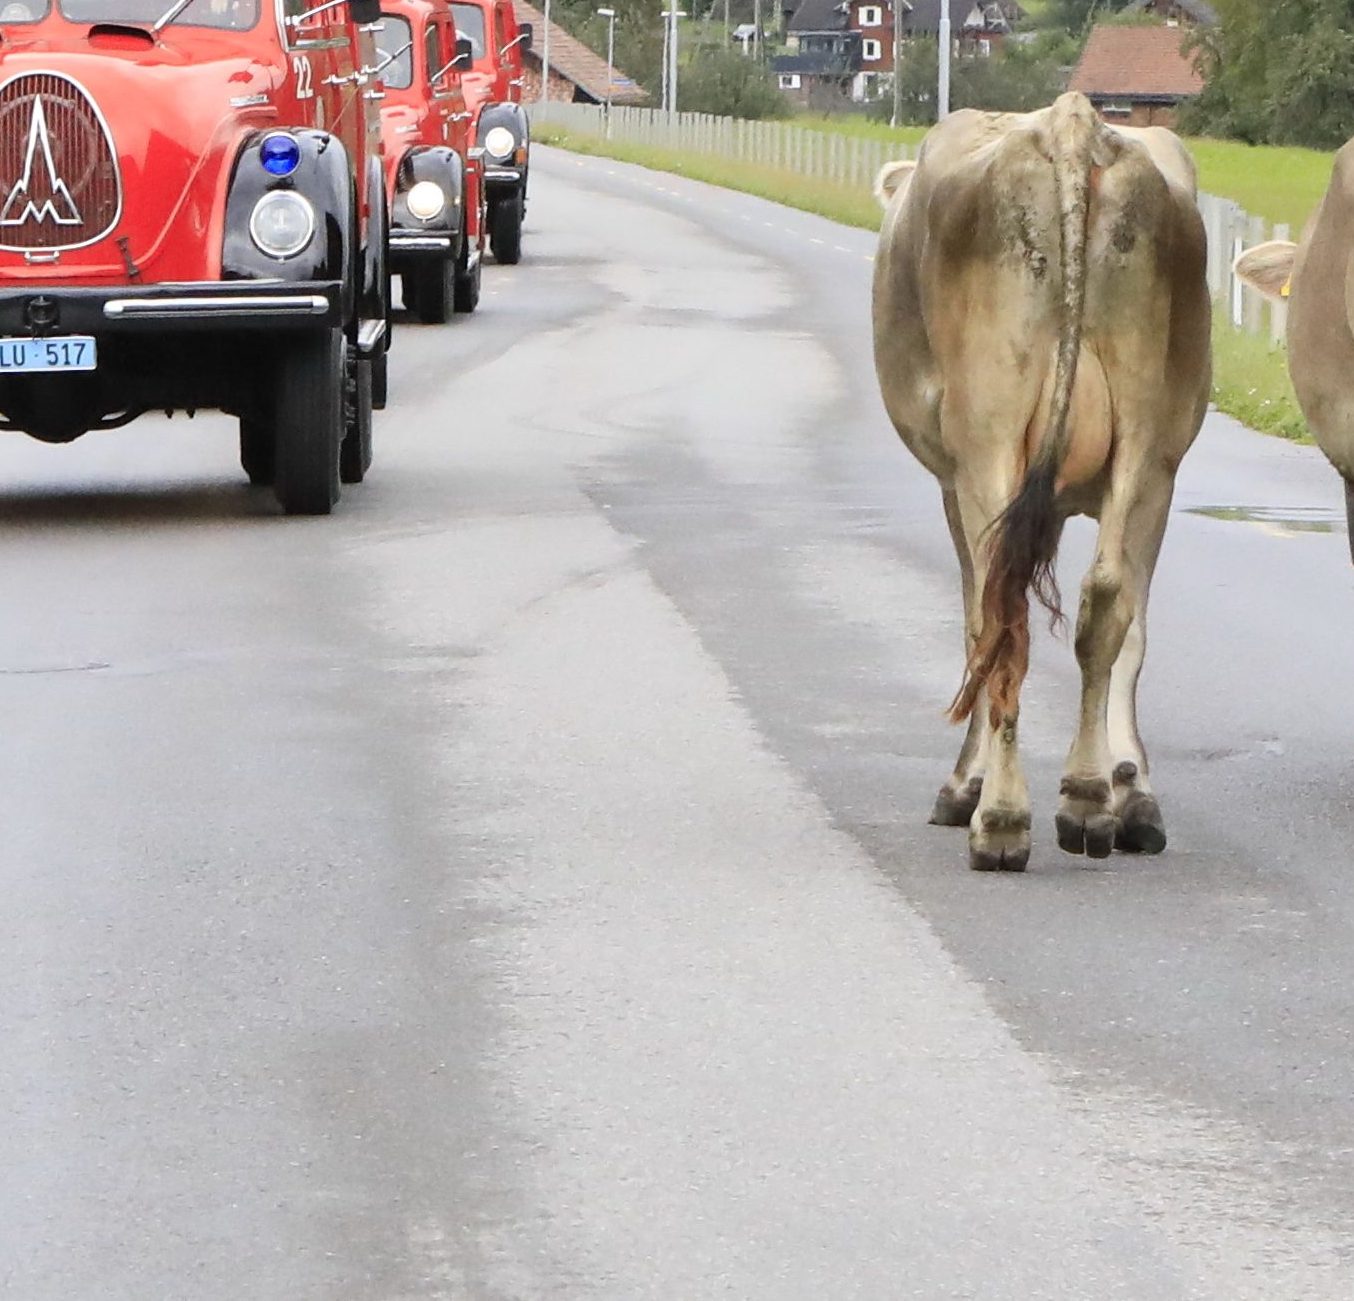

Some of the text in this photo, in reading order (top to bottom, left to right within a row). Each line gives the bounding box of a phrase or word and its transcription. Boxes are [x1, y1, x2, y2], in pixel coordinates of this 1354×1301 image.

[293, 55, 314, 99] 22
[0, 342, 86, 368] LU 517
